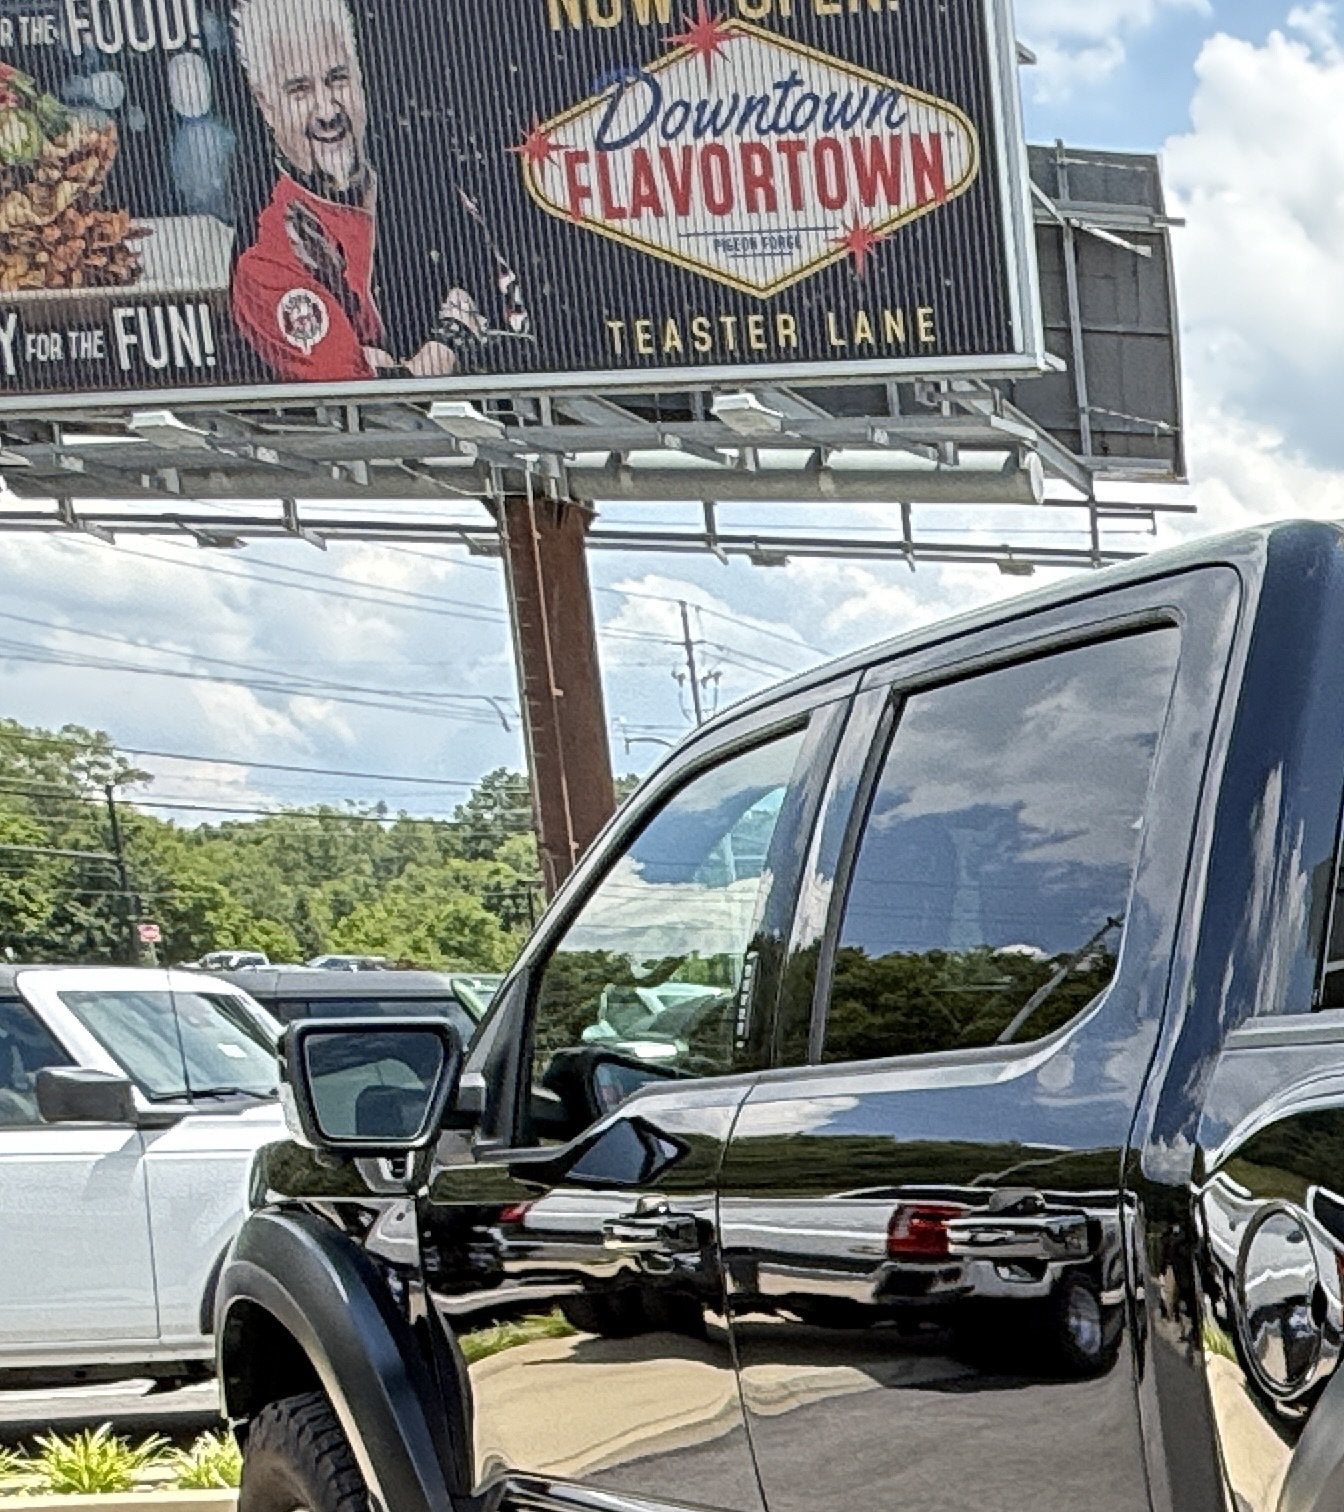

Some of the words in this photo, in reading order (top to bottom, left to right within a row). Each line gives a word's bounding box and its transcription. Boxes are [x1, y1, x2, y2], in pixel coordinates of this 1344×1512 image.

[19, 16, 59, 46] THE
[593, 67, 908, 151] Downtown
[564, 132, 946, 222] FLAVORTOWN
[25, 332, 63, 362] FOR
[67, 330, 104, 359] THE
[112, 303, 215, 370] FUN!
[608, 313, 798, 355] TEASTER
[829, 307, 937, 346] LANE
